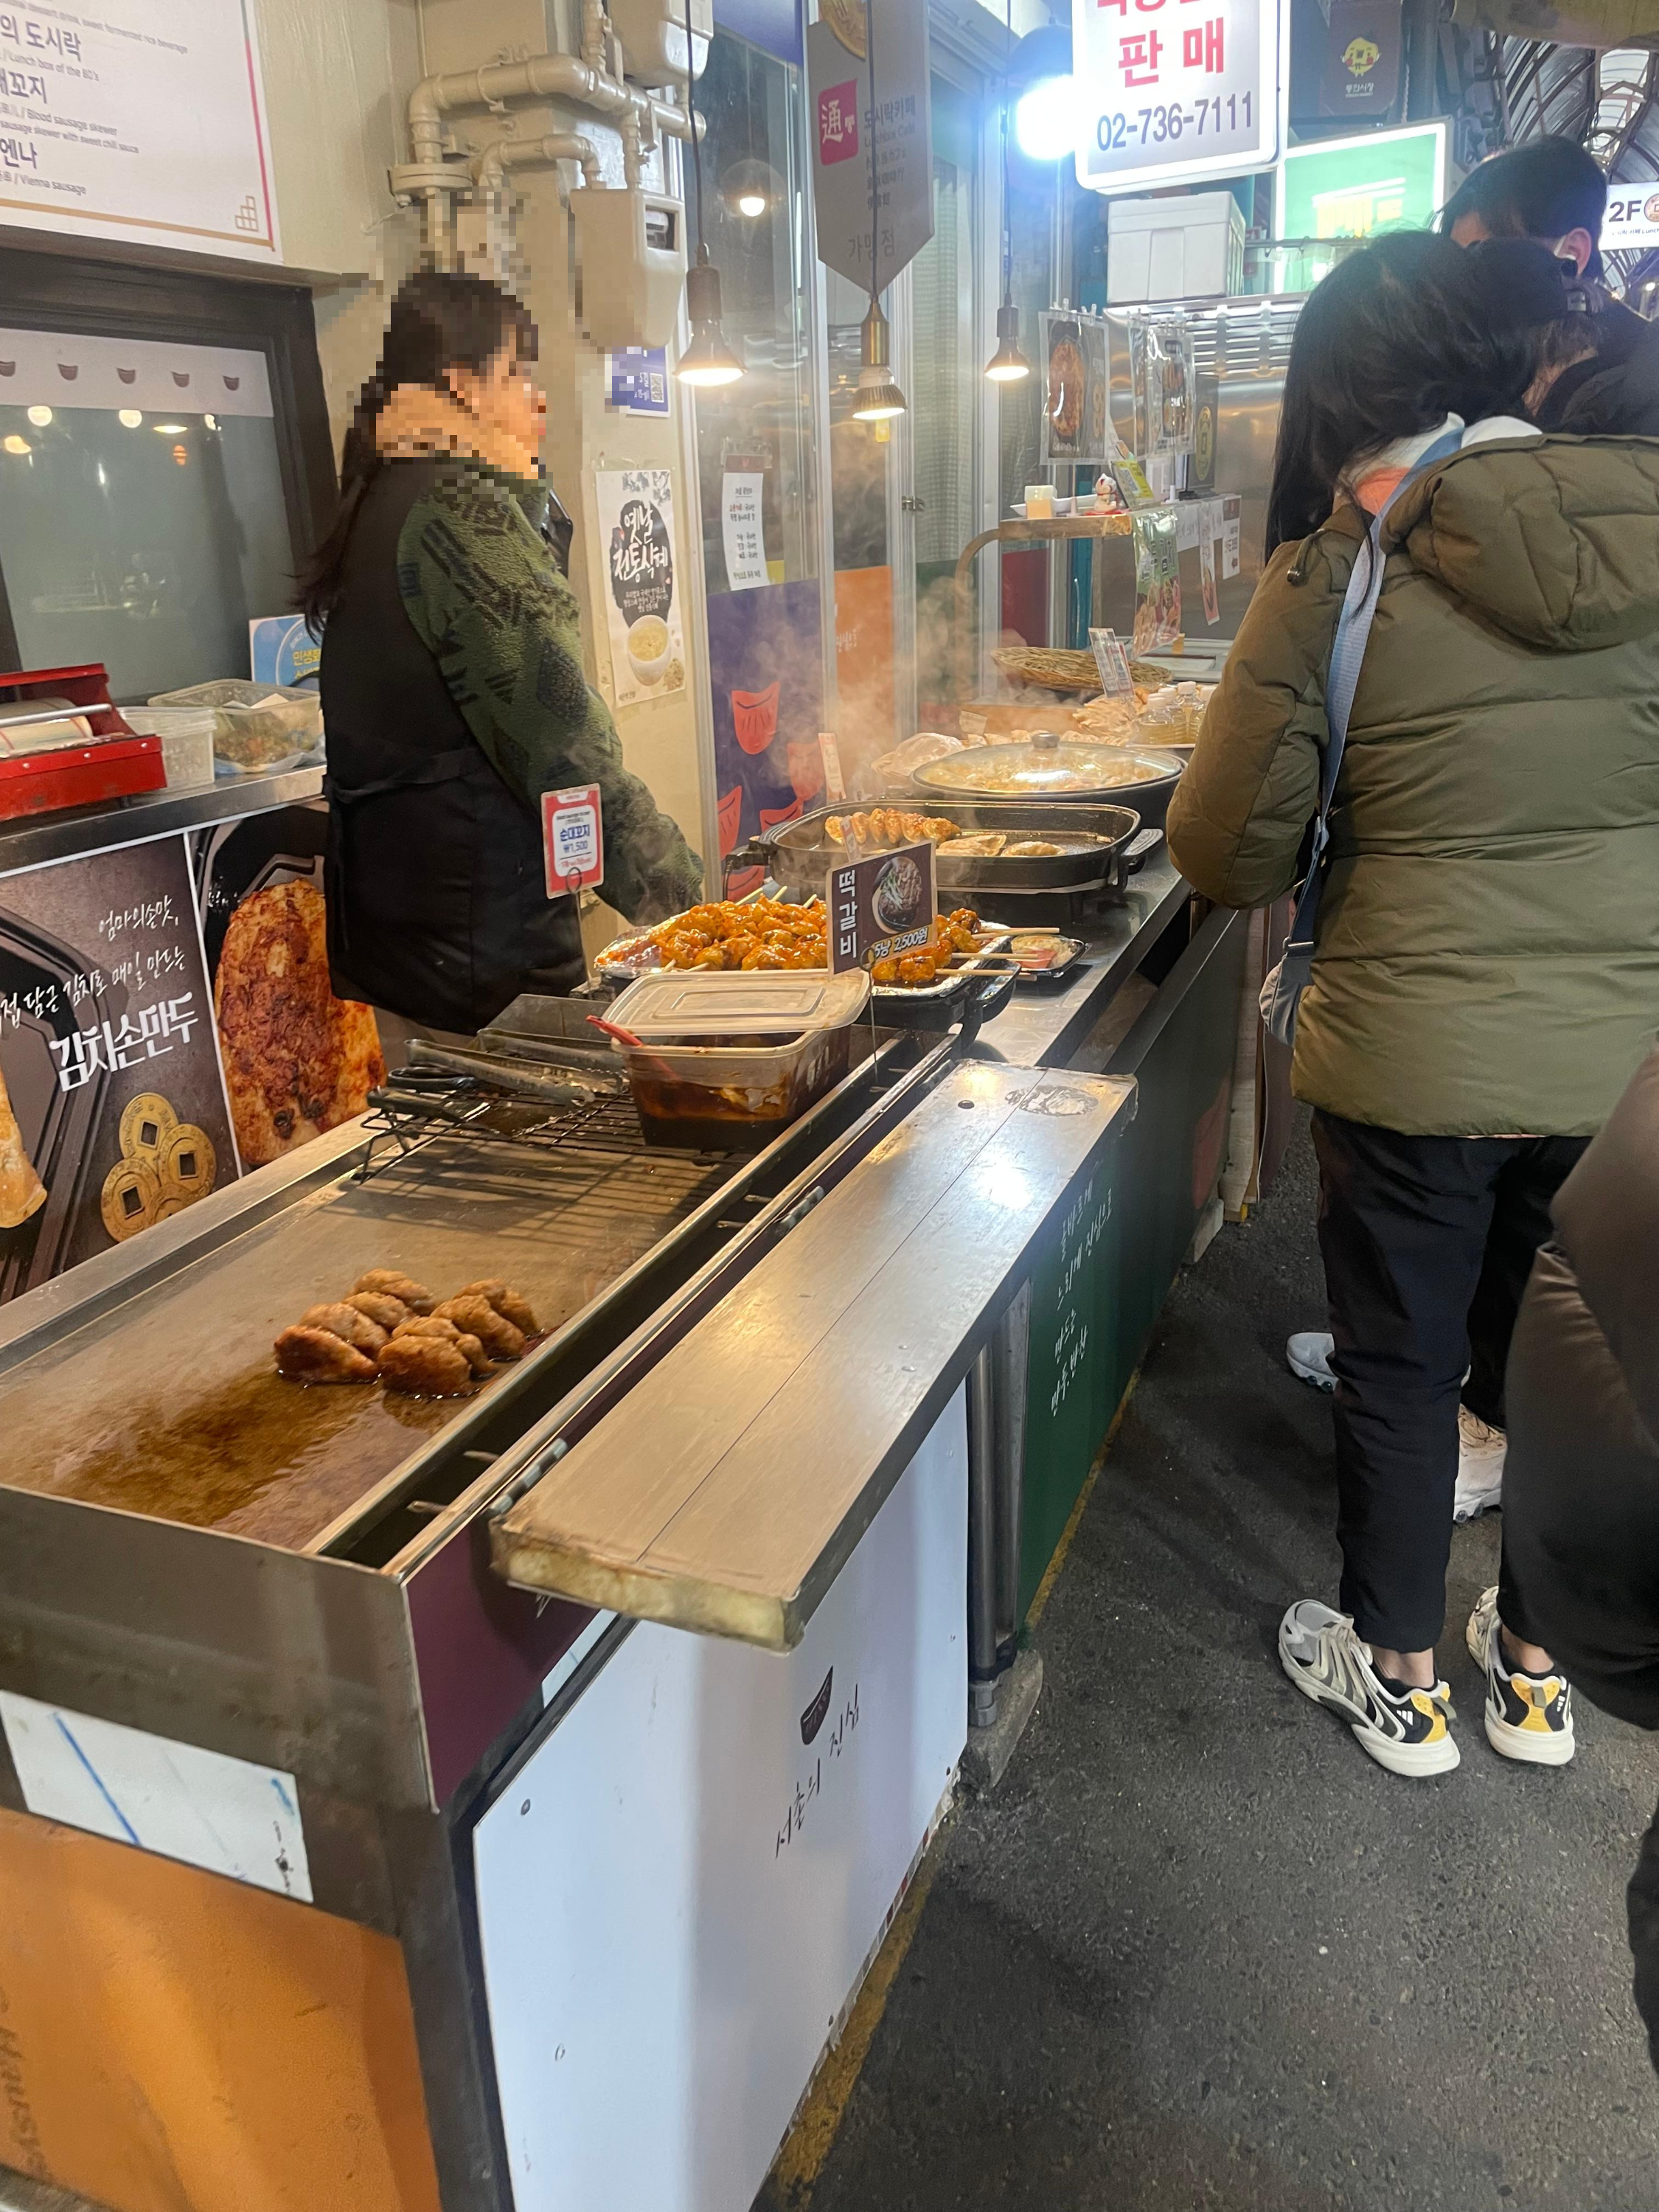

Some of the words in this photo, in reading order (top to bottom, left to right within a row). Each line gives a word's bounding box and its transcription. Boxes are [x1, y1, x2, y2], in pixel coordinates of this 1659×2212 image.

[25, 21, 82, 63] 도시락
[27, 108, 52, 123] Blood
[53, 116, 88, 131] sausage
[1096, 90, 1252, 152] 02-736-7111
[1608, 199, 1643, 223] 2F
[624, 505, 653, 545] 옛날
[613, 542, 669, 582] 전통식혜
[838, 869, 858, 959] 떡갈비
[0, 992, 21, 1029] 접
[24, 985, 59, 1019] 담근
[63, 970, 108, 1006] 김치로
[112, 952, 147, 991] 매일
[147, 946, 185, 979] 만드는
[49, 992, 198, 1092] 김치손만두
[1054, 1308, 1077, 1365] 만드는
[775, 1756, 821, 1859] 서촌의
